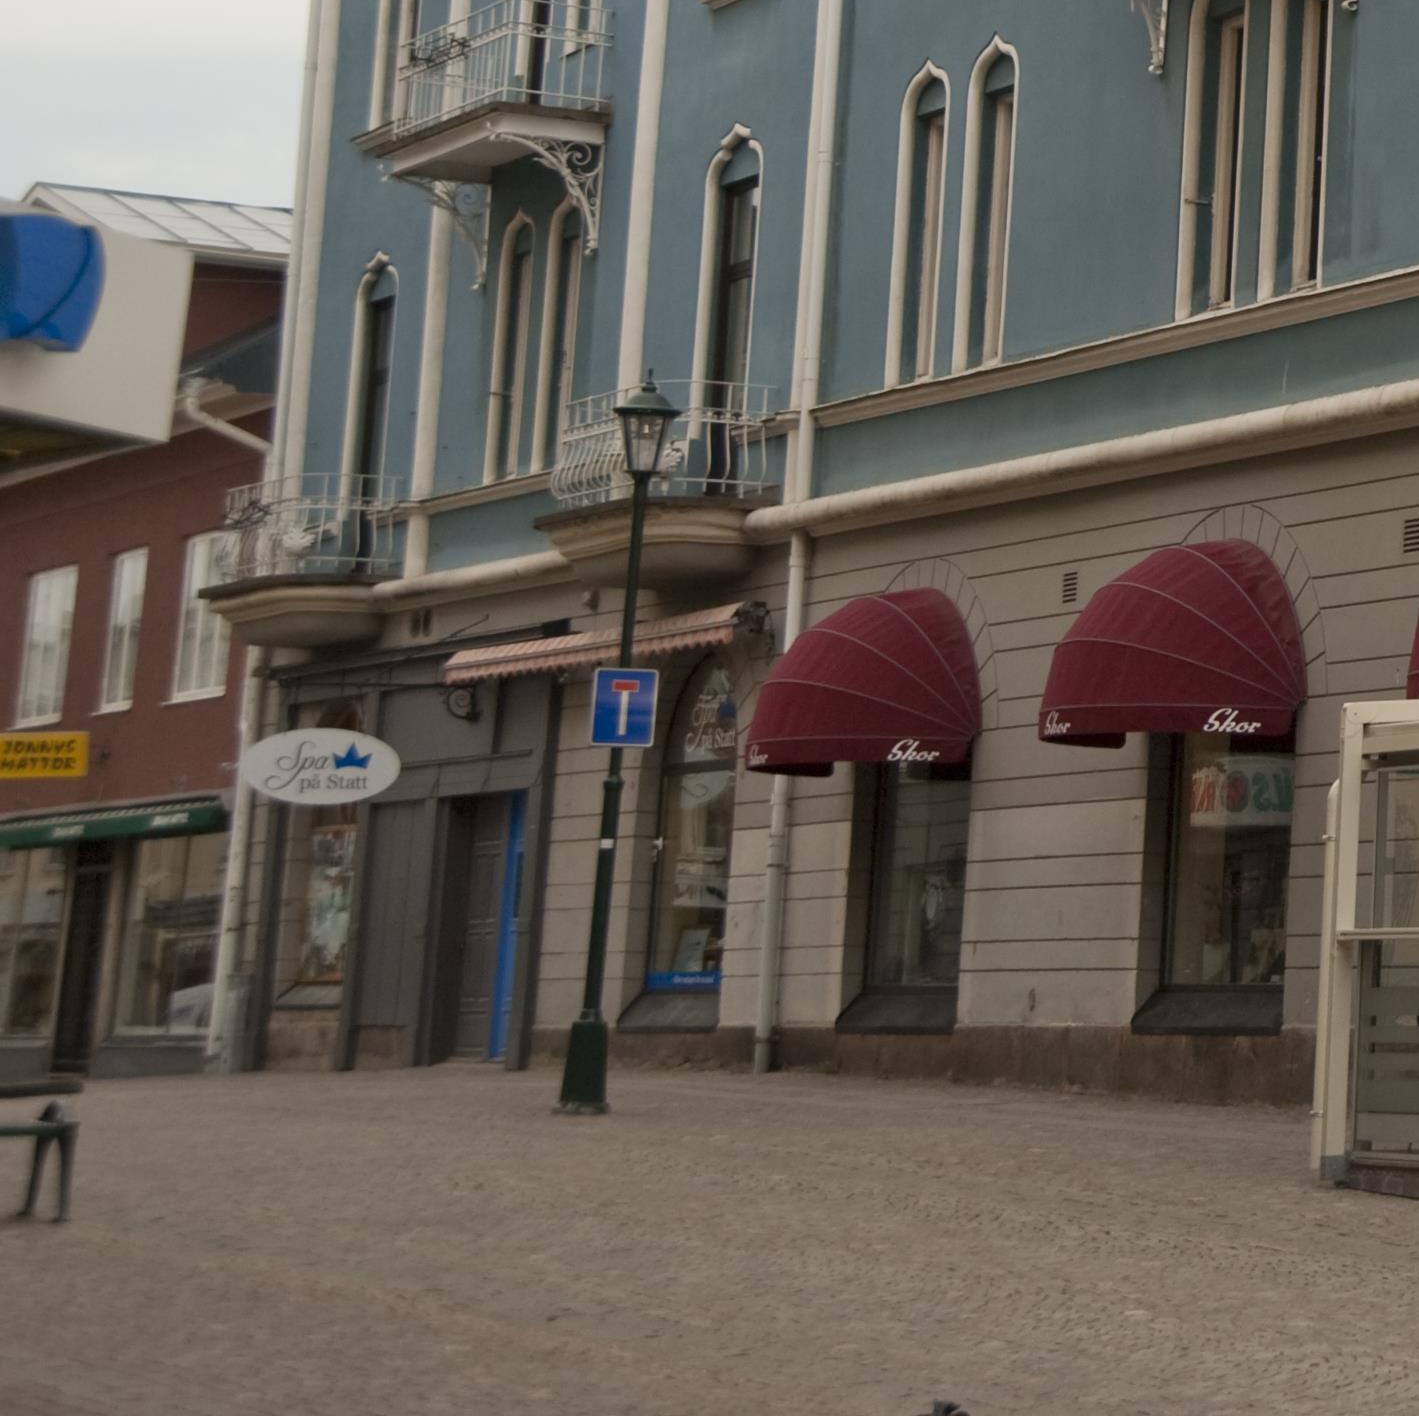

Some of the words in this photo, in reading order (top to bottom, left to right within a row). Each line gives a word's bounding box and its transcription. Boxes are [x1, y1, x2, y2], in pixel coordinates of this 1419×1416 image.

[1044, 710, 1072, 736] Skor
[1202, 707, 1262, 734] Skor
[887, 738, 941, 762] Skor
[264, 740, 330, 792] Spa
[298, 774, 321, 794] på
[325, 773, 368, 790] Statt
